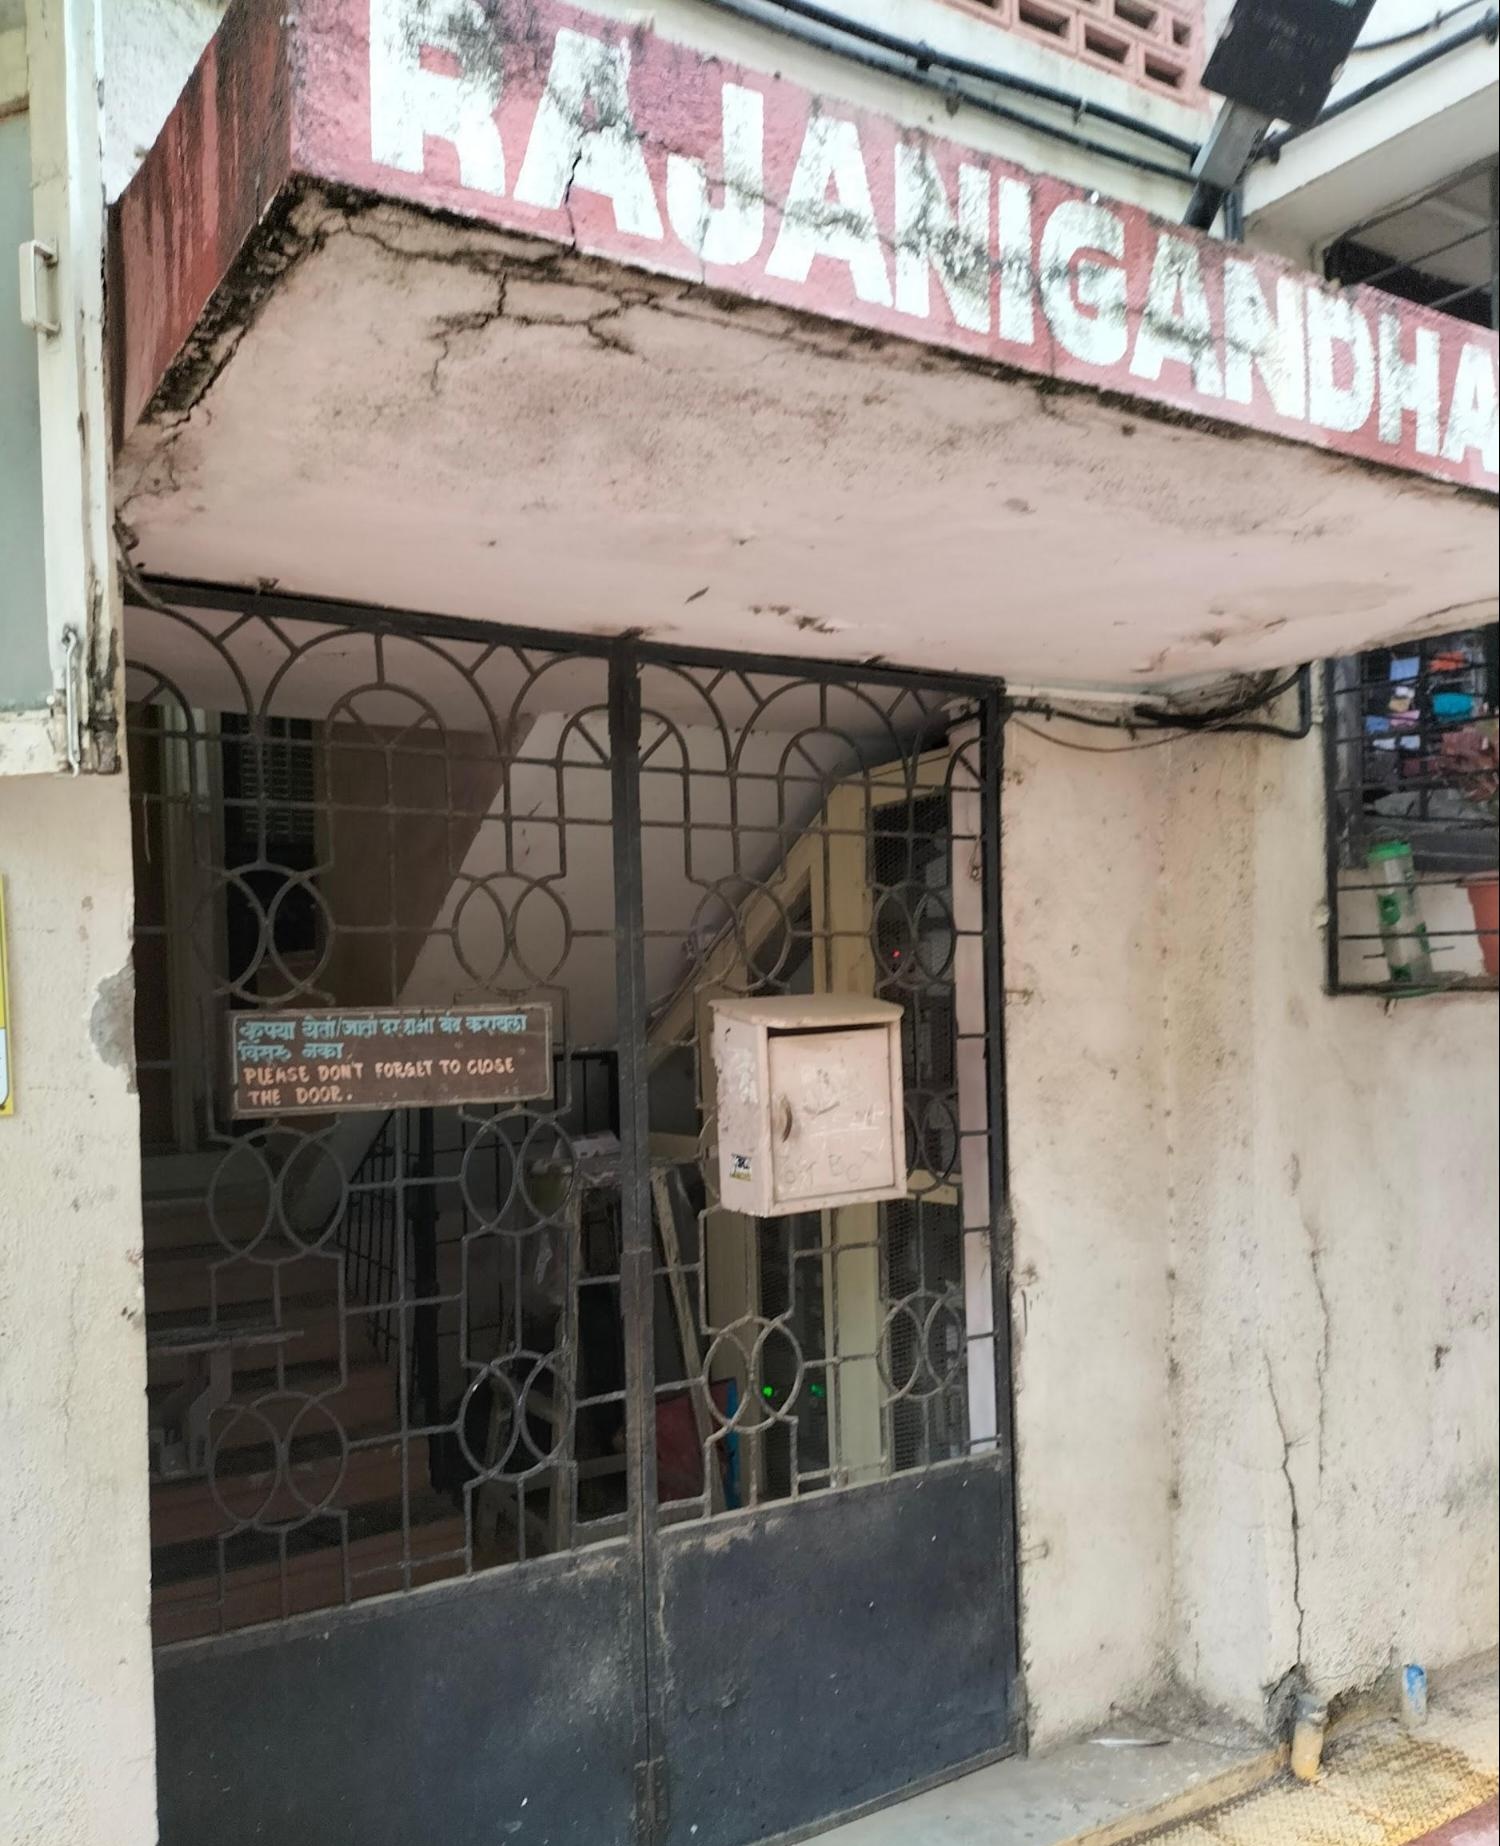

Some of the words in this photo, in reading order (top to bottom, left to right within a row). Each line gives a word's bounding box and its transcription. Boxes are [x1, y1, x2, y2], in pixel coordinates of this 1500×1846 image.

[369, 0, 1498, 474] RAJANIGANDHA
[243, 1065, 310, 1086] PLEASE
[317, 1061, 364, 1082] DON'T
[374, 1060, 432, 1080] FORGET
[438, 1060, 461, 1076] TO
[466, 1057, 516, 1076] CLOSE
[247, 1088, 282, 1106] THE
[295, 1085, 354, 1105] DOOR.
